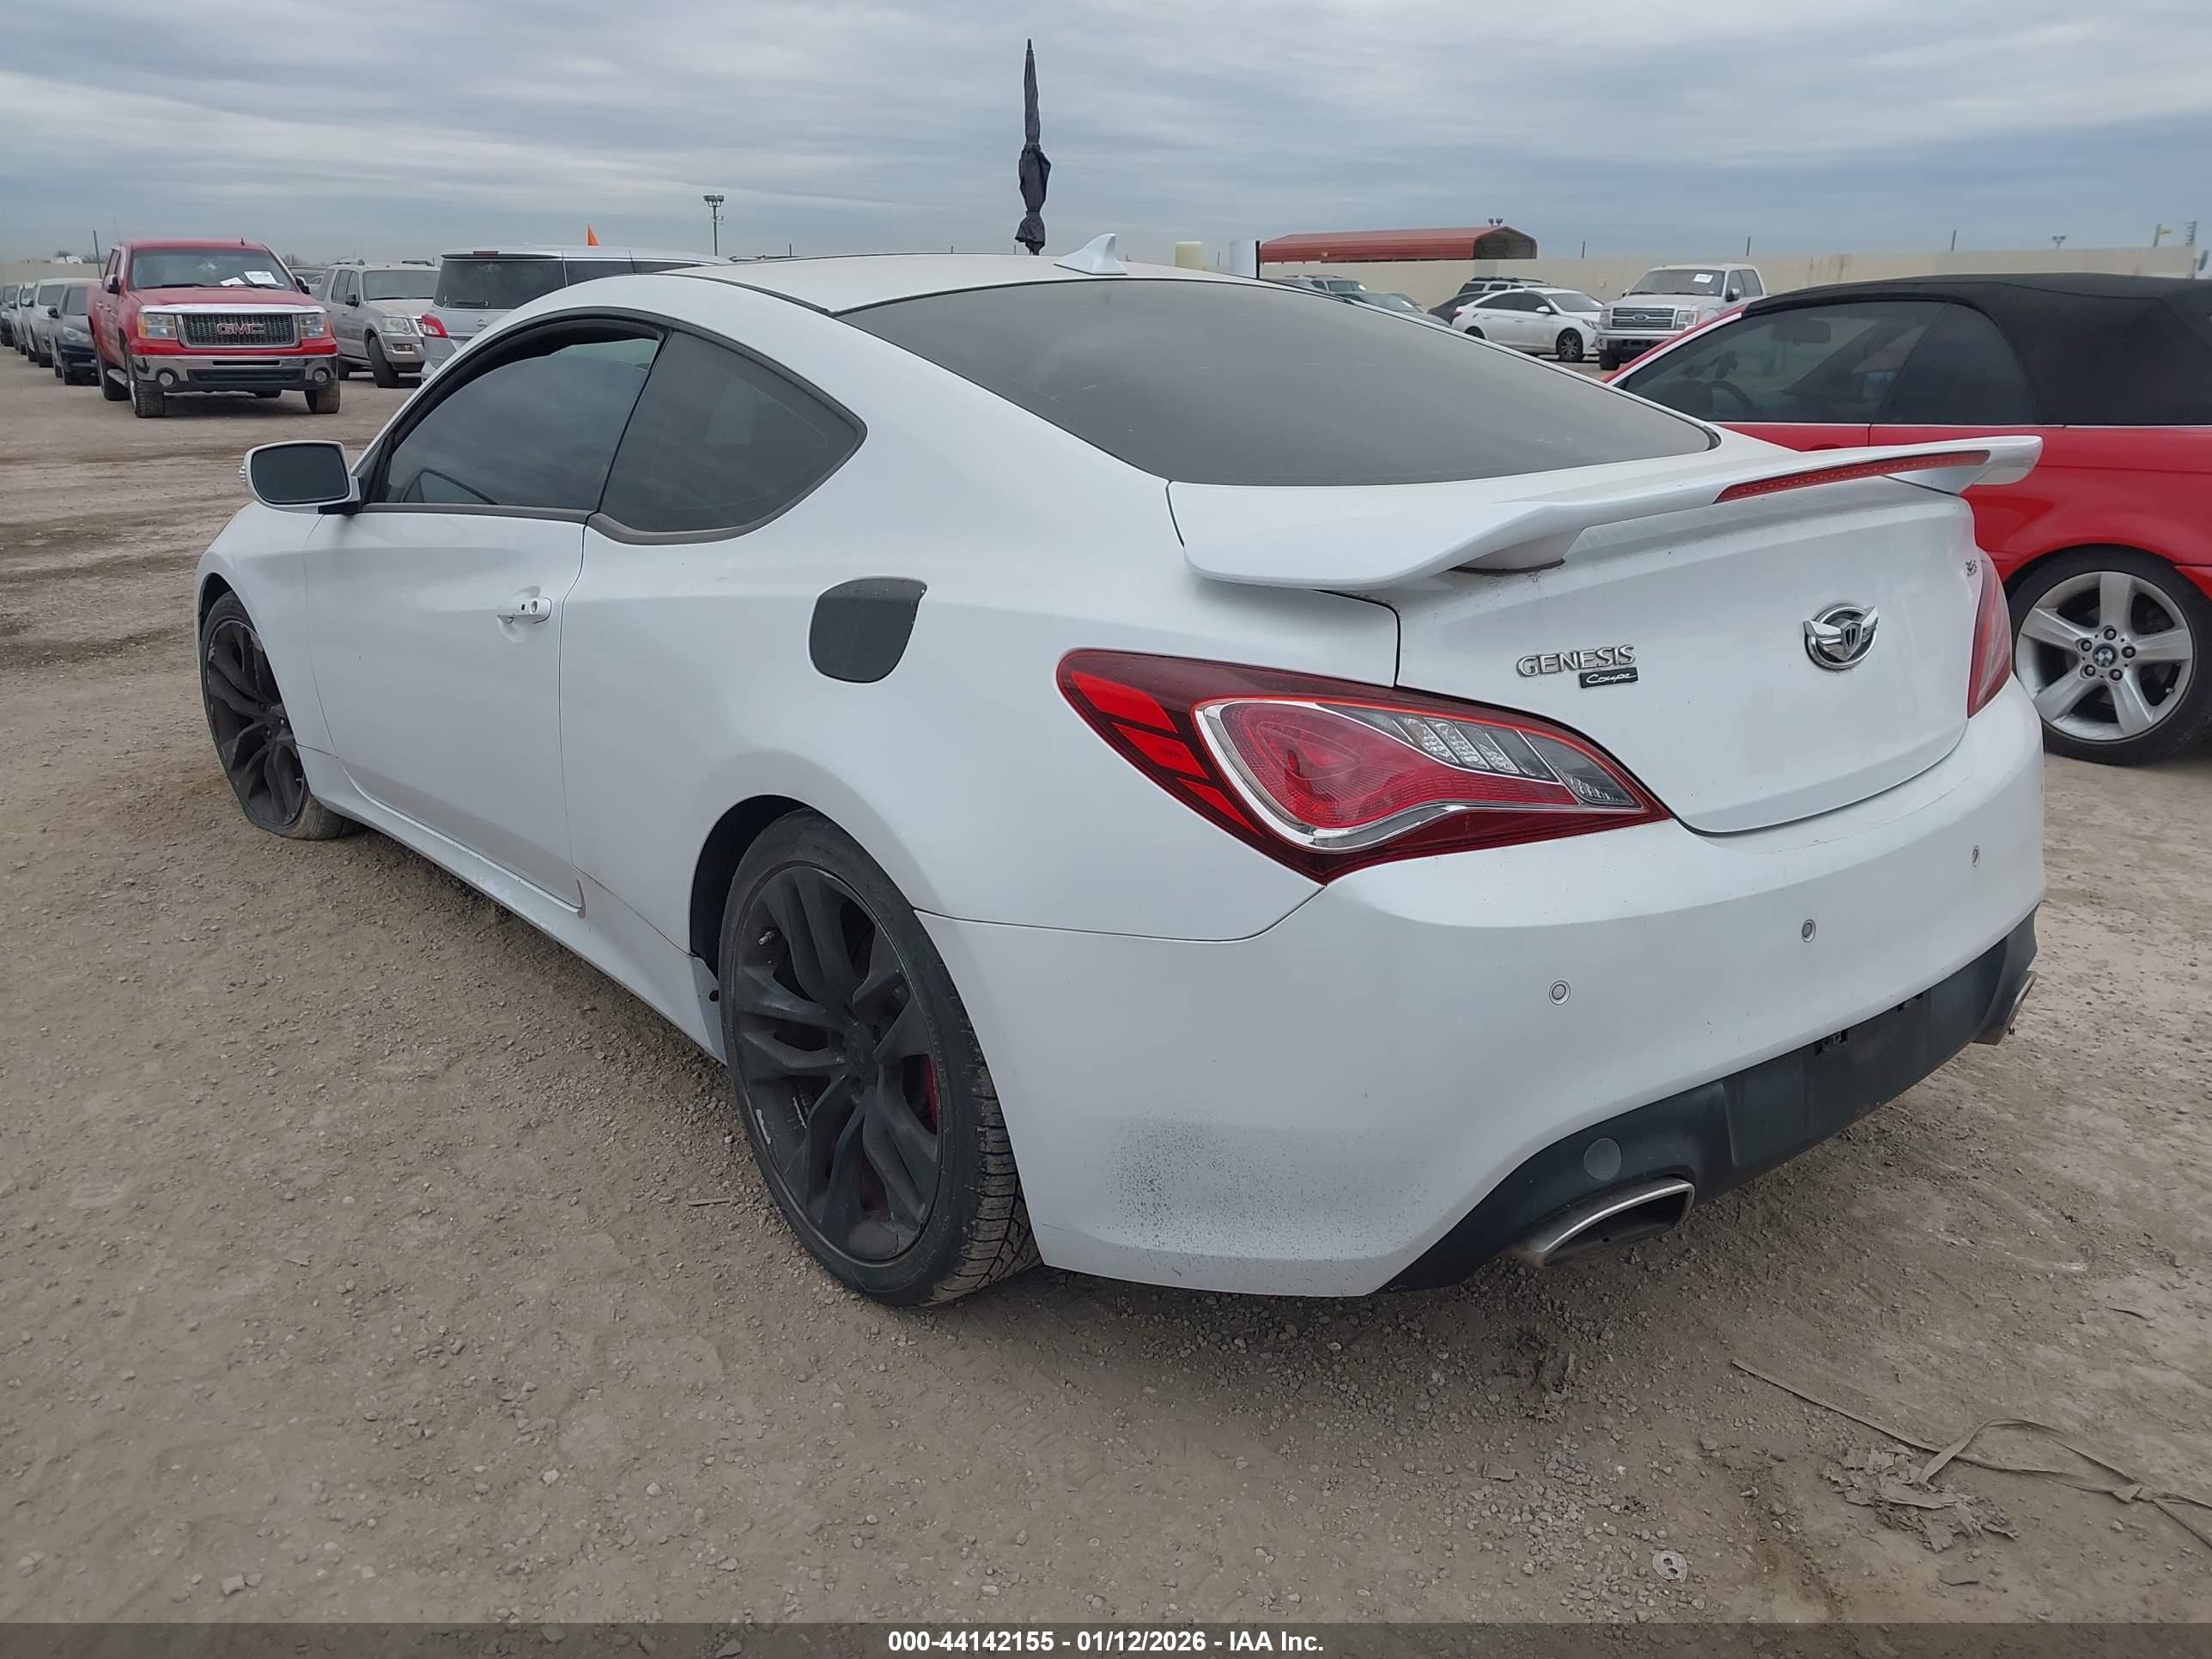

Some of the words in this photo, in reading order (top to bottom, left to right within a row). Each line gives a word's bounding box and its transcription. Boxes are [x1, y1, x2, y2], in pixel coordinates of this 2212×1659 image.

[216, 323, 264, 335] GMC
[1516, 644, 1636, 677] GENESIS
[1586, 672, 1637, 684] Coupe
